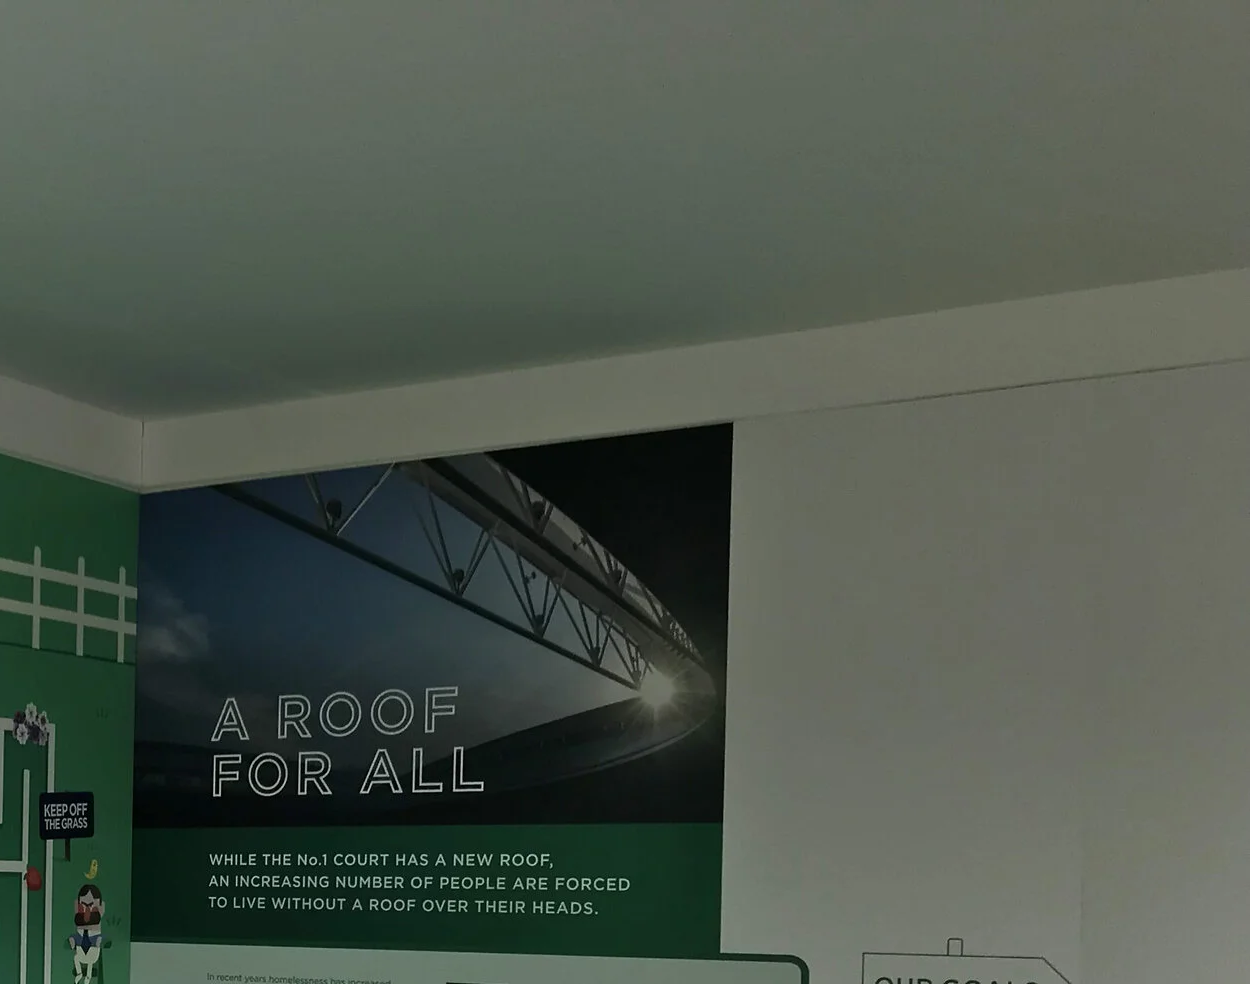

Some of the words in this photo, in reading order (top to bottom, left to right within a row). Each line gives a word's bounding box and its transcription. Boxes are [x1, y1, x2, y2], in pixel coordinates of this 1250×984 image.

[211, 698, 249, 741] A
[278, 686, 458, 740] ROOF
[212, 752, 332, 797] FOR
[360, 747, 484, 794] ALL
[44, 804, 68, 817] KEEP
[69, 803, 88, 816] OFF
[44, 819, 61, 830] THE
[61, 818, 88, 829] GRASS
[209, 854, 257, 866] WHILE
[262, 854, 291, 866] THE
[297, 854, 327, 866] No.1
[333, 854, 389, 866] COURT
[395, 854, 429, 866] HAS
[435, 854, 446, 866] A
[453, 854, 493, 866] NEW
[500, 854, 554, 869] ROOF,
[208, 875, 229, 887] AN
[235, 876, 329, 888] INCREASING
[335, 876, 404, 888] NUMBER
[410, 876, 433, 889] OF
[439, 876, 506, 889] PEOPLE
[512, 877, 548, 890] ARE
[555, 877, 631, 891] FORCED
[208, 896, 228, 908] TO
[233, 897, 266, 909] LIVE
[271, 897, 346, 910] WITHOUT
[352, 898, 363, 911] A
[369, 899, 416, 911] ROOF
[422, 900, 468, 912] OVER
[475, 900, 525, 913] THEIR
[532, 901, 599, 915] HEADS.
[206, 972, 214, 980] In
[244, 975, 266, 983] years
